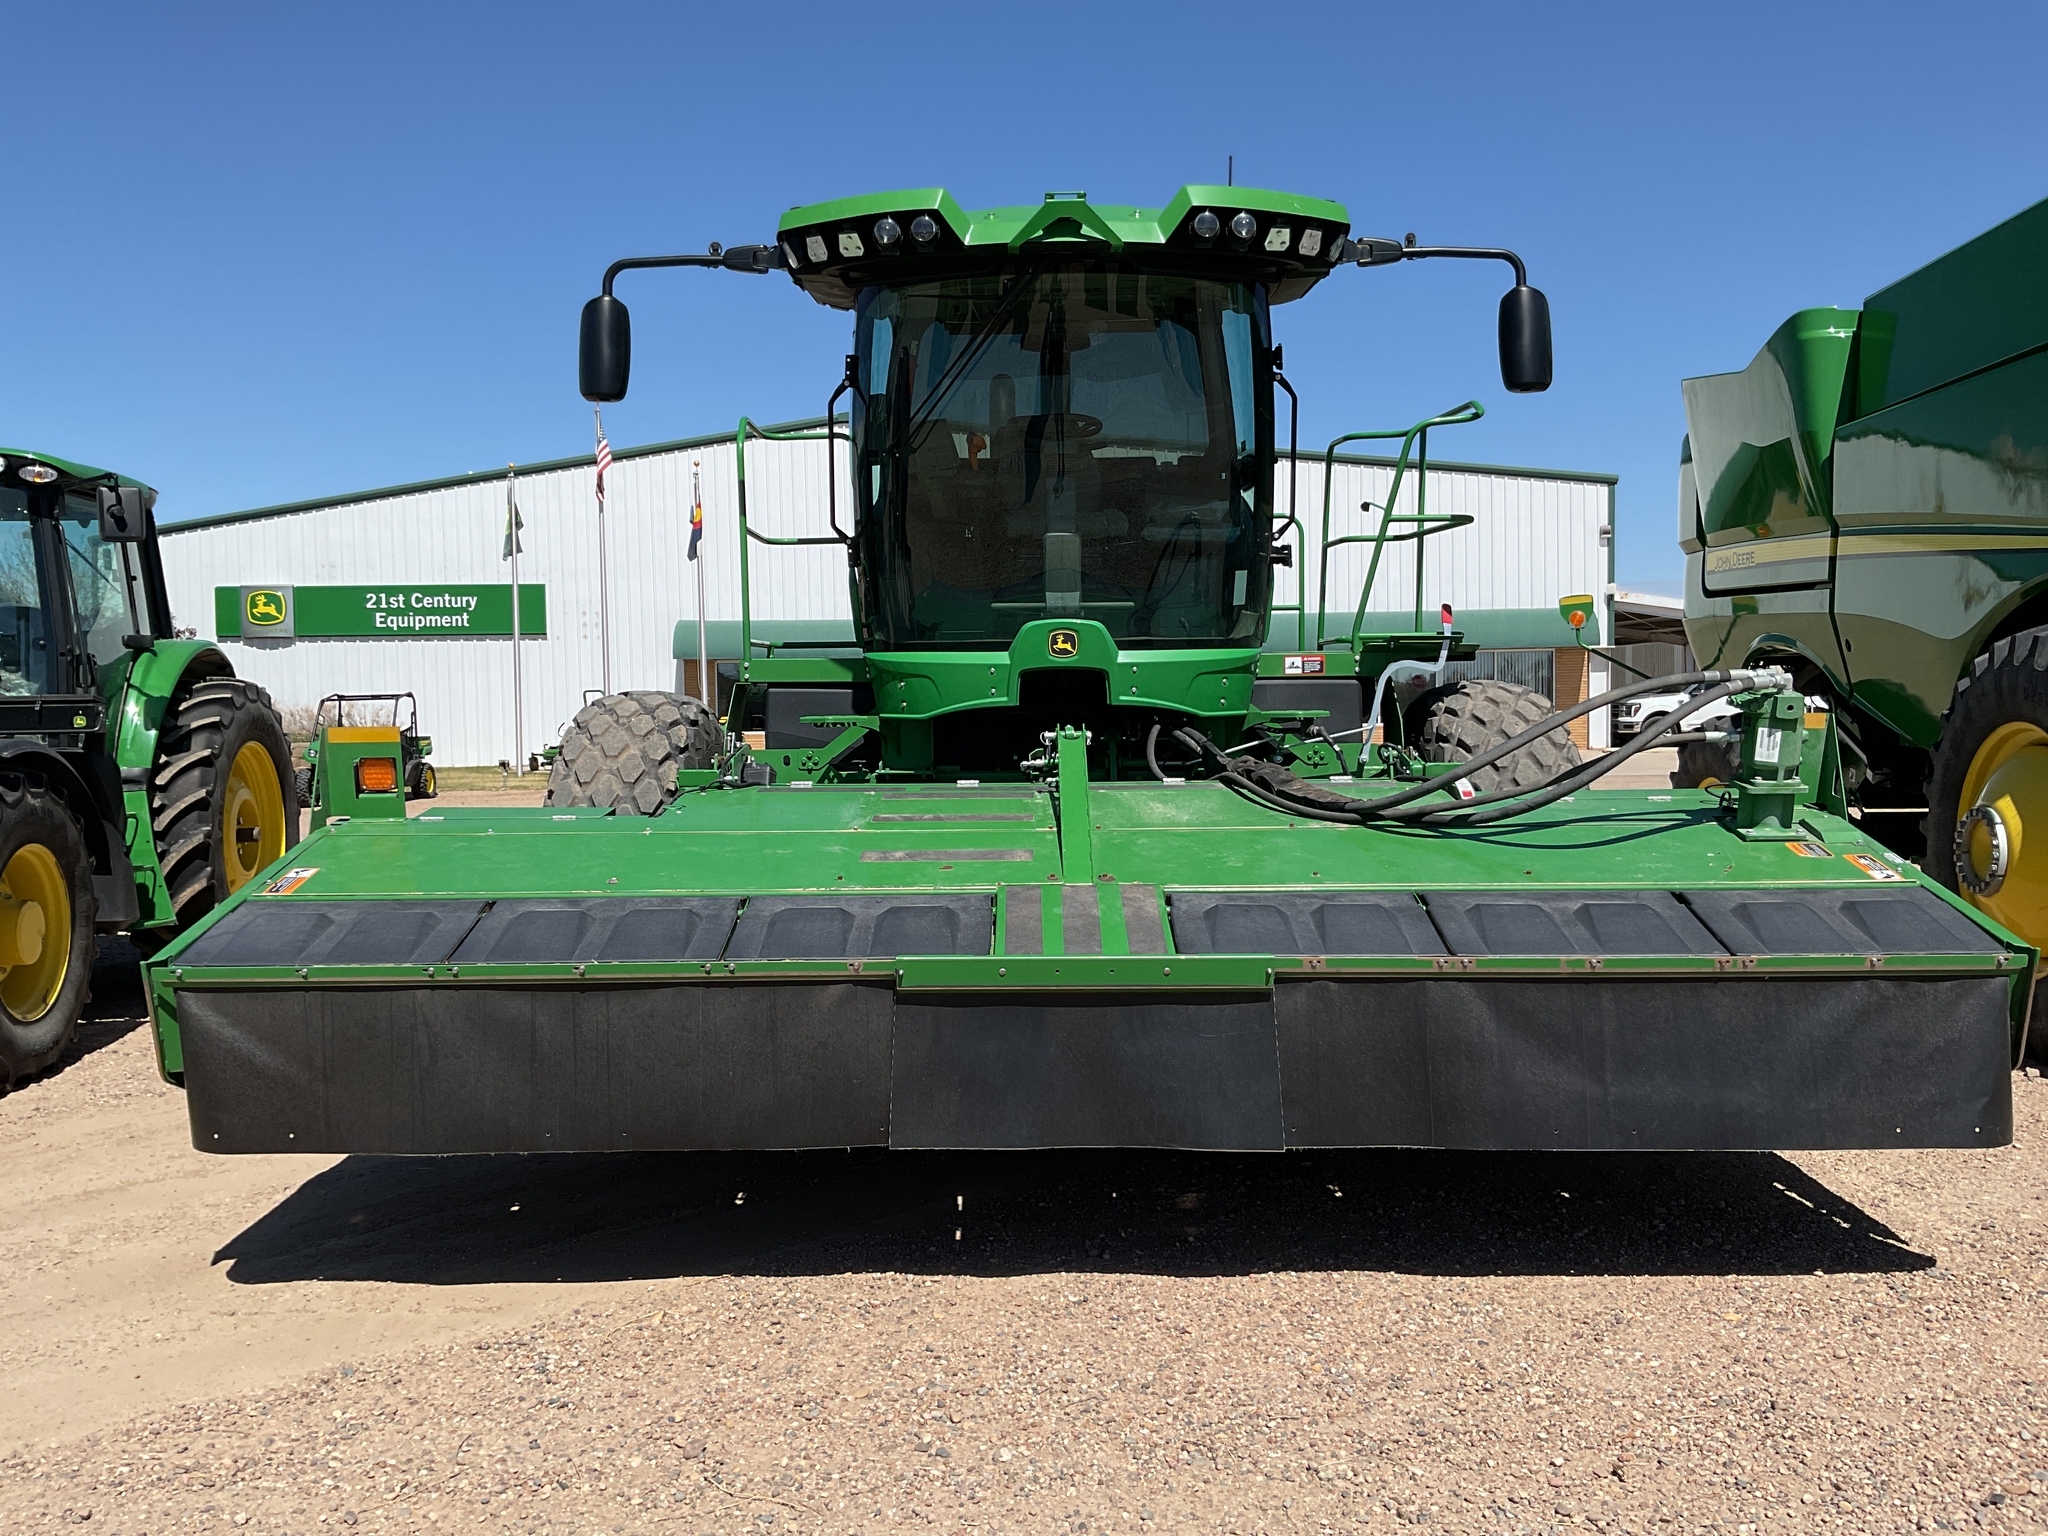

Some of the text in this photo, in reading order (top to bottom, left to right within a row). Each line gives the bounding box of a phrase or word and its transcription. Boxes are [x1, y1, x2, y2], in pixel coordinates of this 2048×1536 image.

[1714, 551, 1755, 570] JOHN DEERE
[365, 592, 477, 611] 21st Century
[375, 612, 470, 631] Equipment
